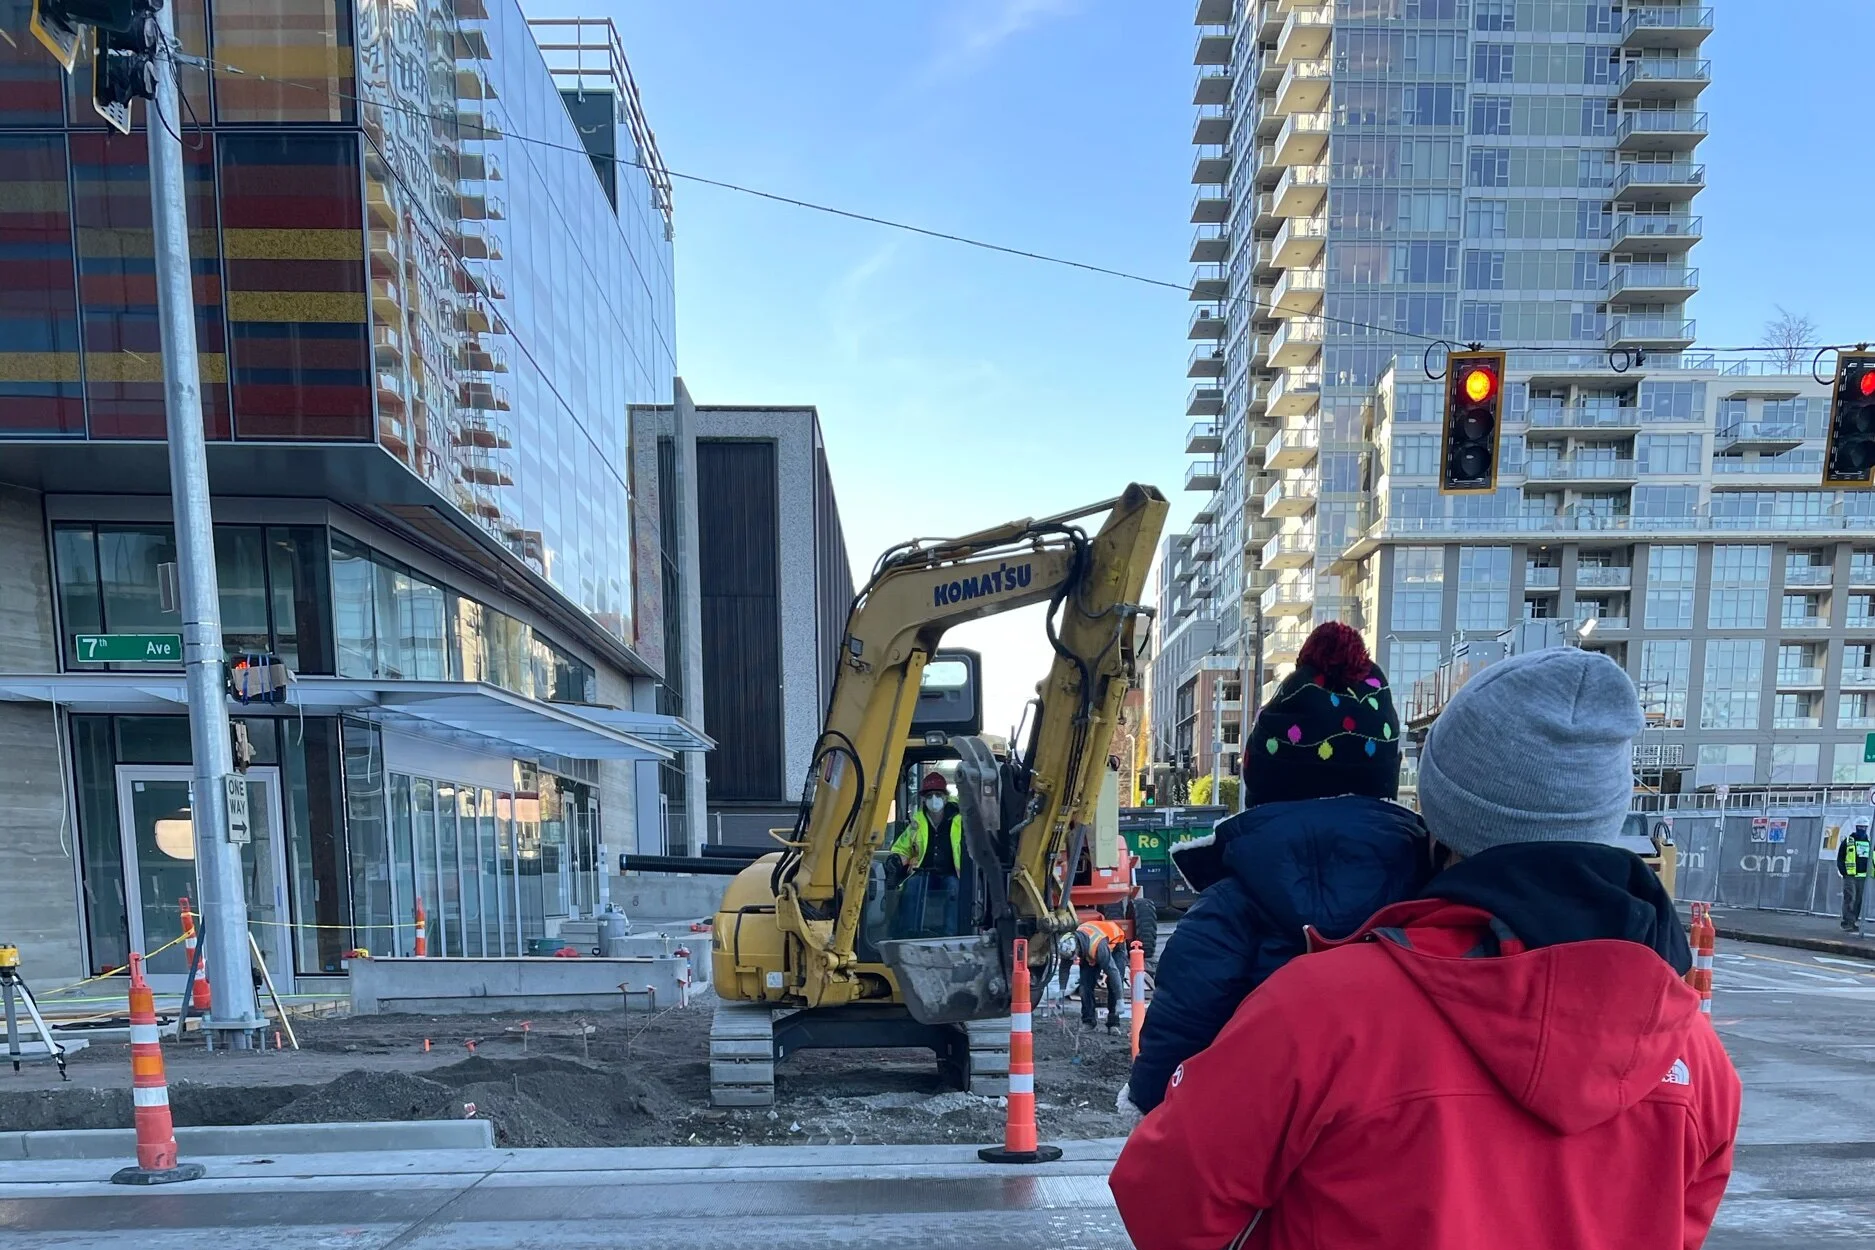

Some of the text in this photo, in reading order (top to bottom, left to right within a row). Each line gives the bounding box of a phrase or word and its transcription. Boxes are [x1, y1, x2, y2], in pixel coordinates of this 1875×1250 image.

[934, 562, 1031, 607] KOMATSU
[82, 638, 171, 658] 7th Ave
[228, 779, 245, 796] ONE
[229, 799, 246, 815] WAY
[1138, 834, 1160, 848] Re
